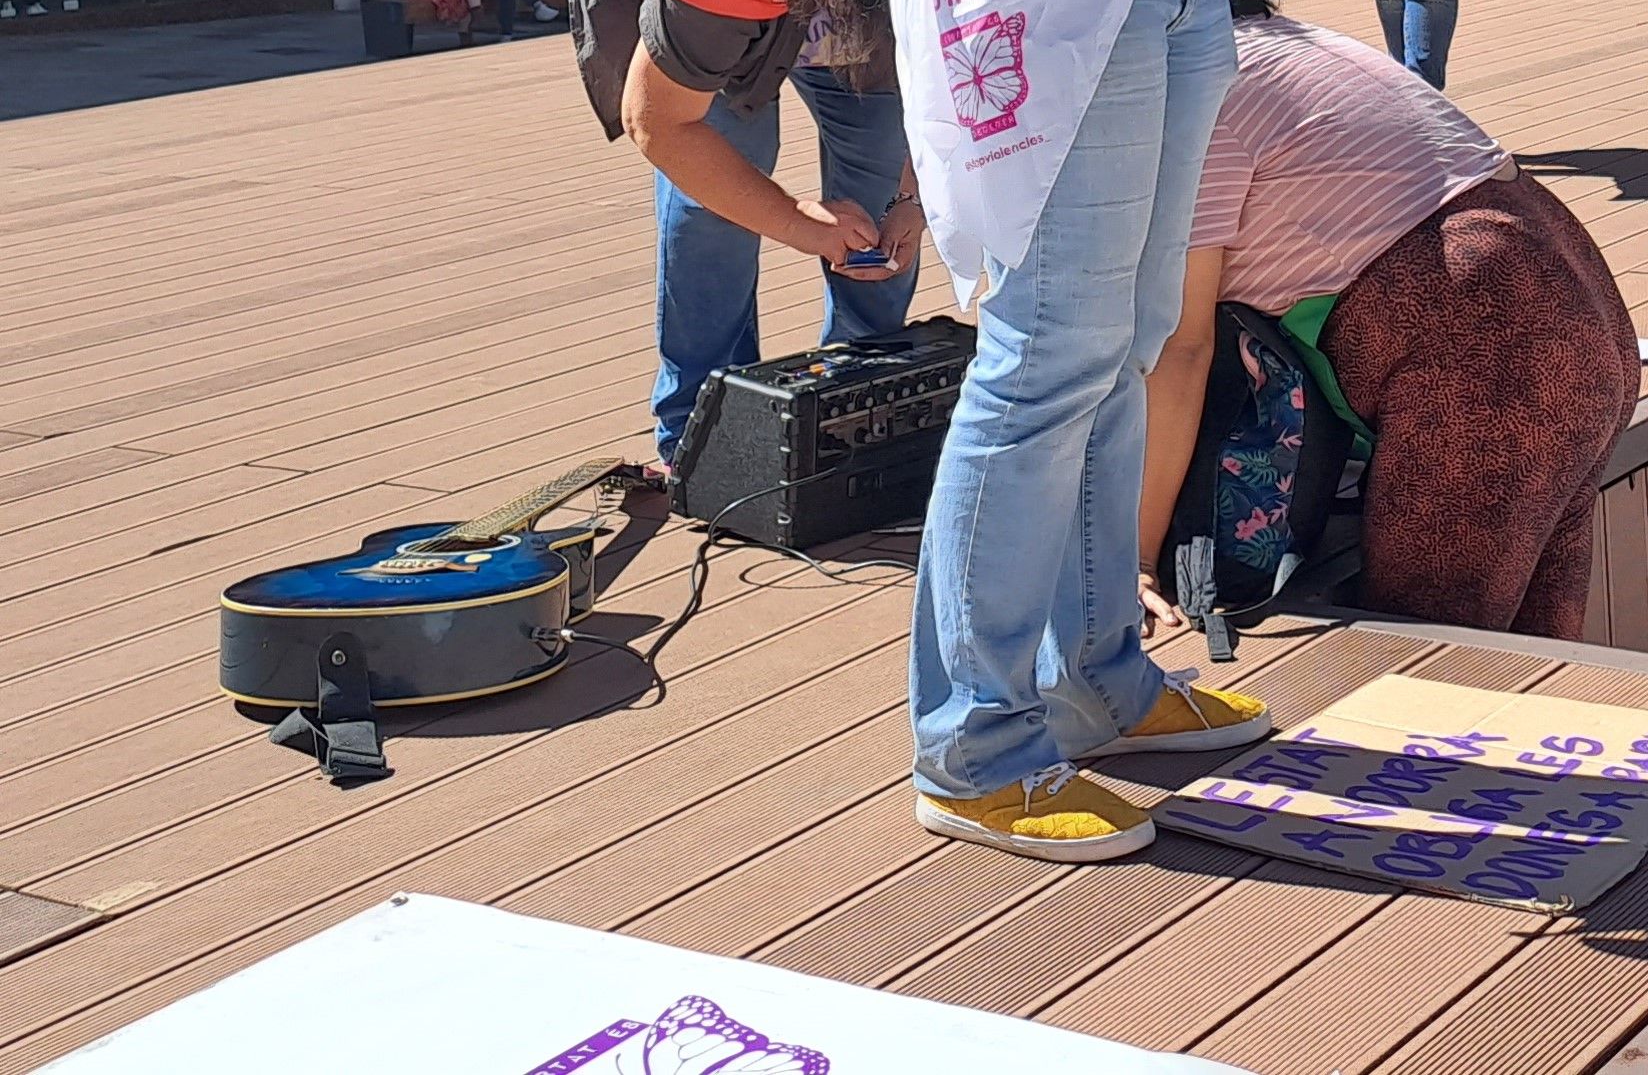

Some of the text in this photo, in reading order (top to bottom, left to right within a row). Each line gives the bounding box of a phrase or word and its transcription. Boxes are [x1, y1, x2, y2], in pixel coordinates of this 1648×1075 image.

[1372, 787, 1544, 877] OBLIGA
[1499, 735, 1605, 782] LES
[1460, 809, 1624, 899] DONES
[1578, 789, 1648, 811] A
